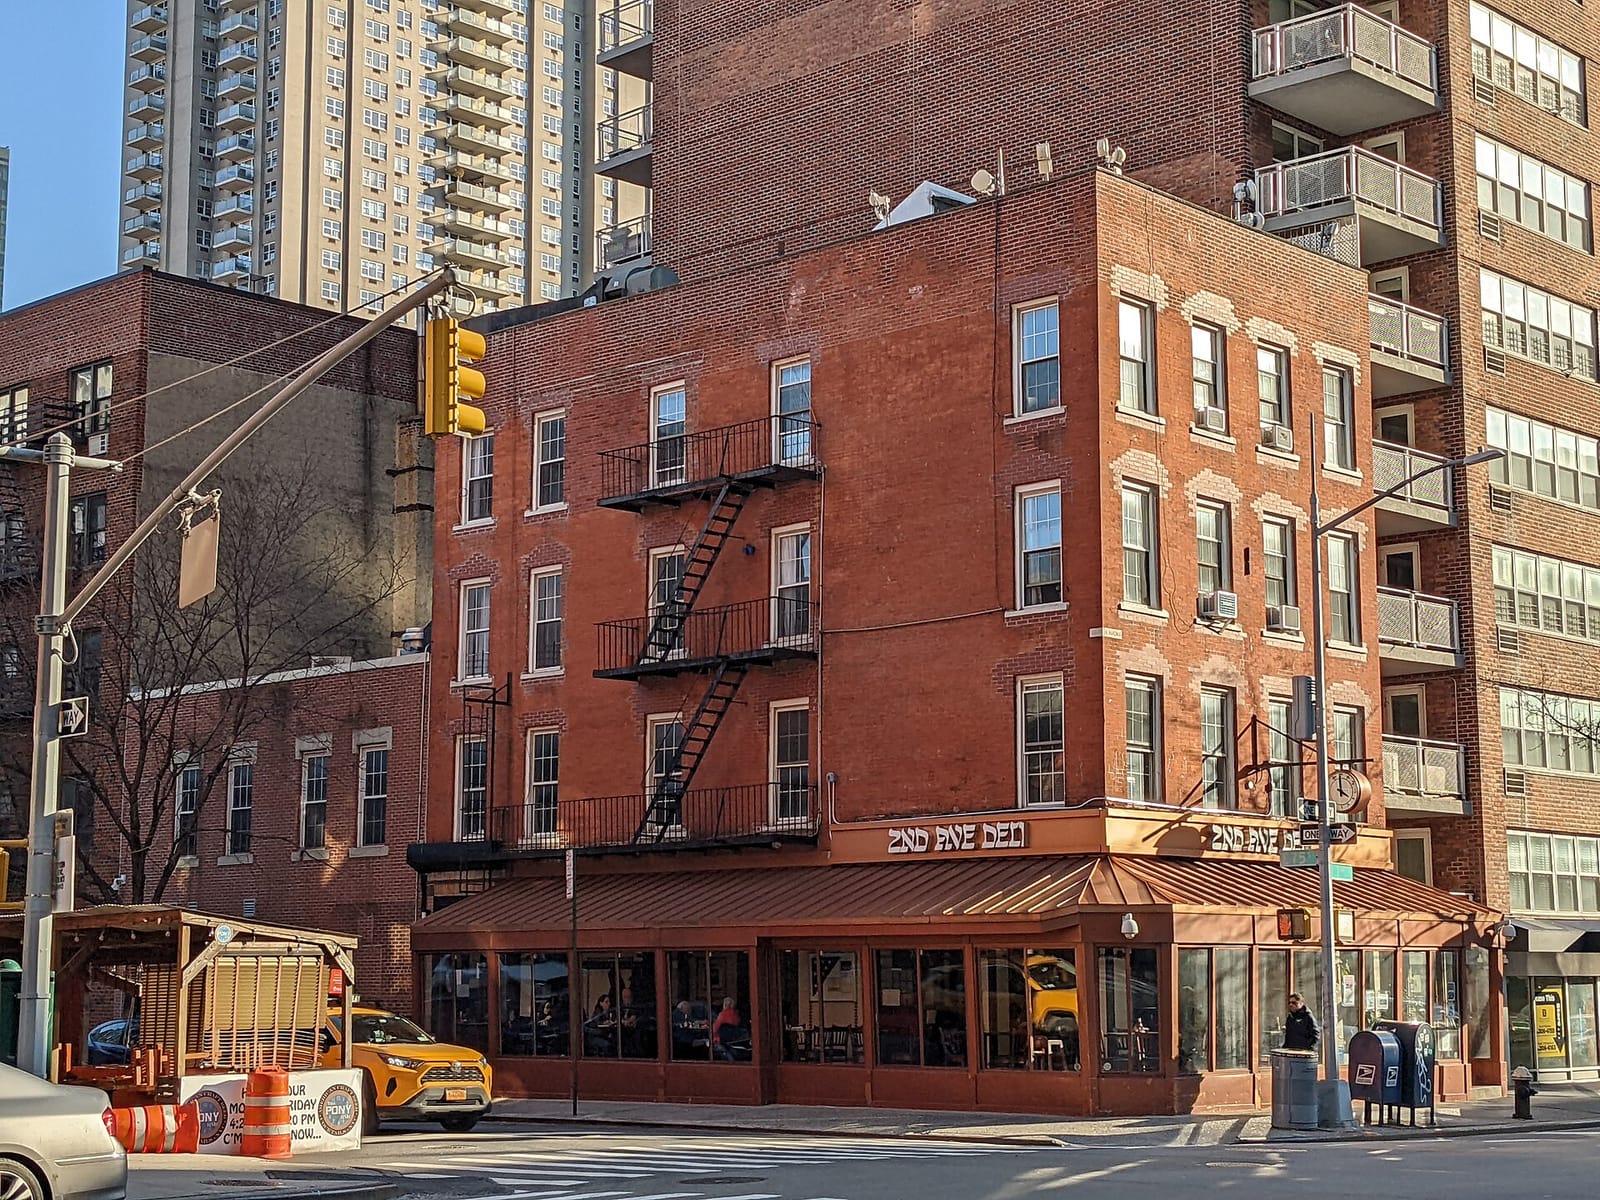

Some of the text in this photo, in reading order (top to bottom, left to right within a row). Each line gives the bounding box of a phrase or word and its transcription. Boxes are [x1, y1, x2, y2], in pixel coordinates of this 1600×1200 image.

[887, 821, 1025, 853] 2ND AVE DELI
[1212, 823, 1245, 851] 2ND
[1247, 826, 1279, 853] AVE
[1331, 829, 1349, 839] WAY
[289, 1085, 306, 1096] OUR
[289, 1099, 317, 1111] RIDAY
[325, 1105, 352, 1115] PONY
[200, 1112, 219, 1122] ONY
[301, 1114, 316, 1125] PM
